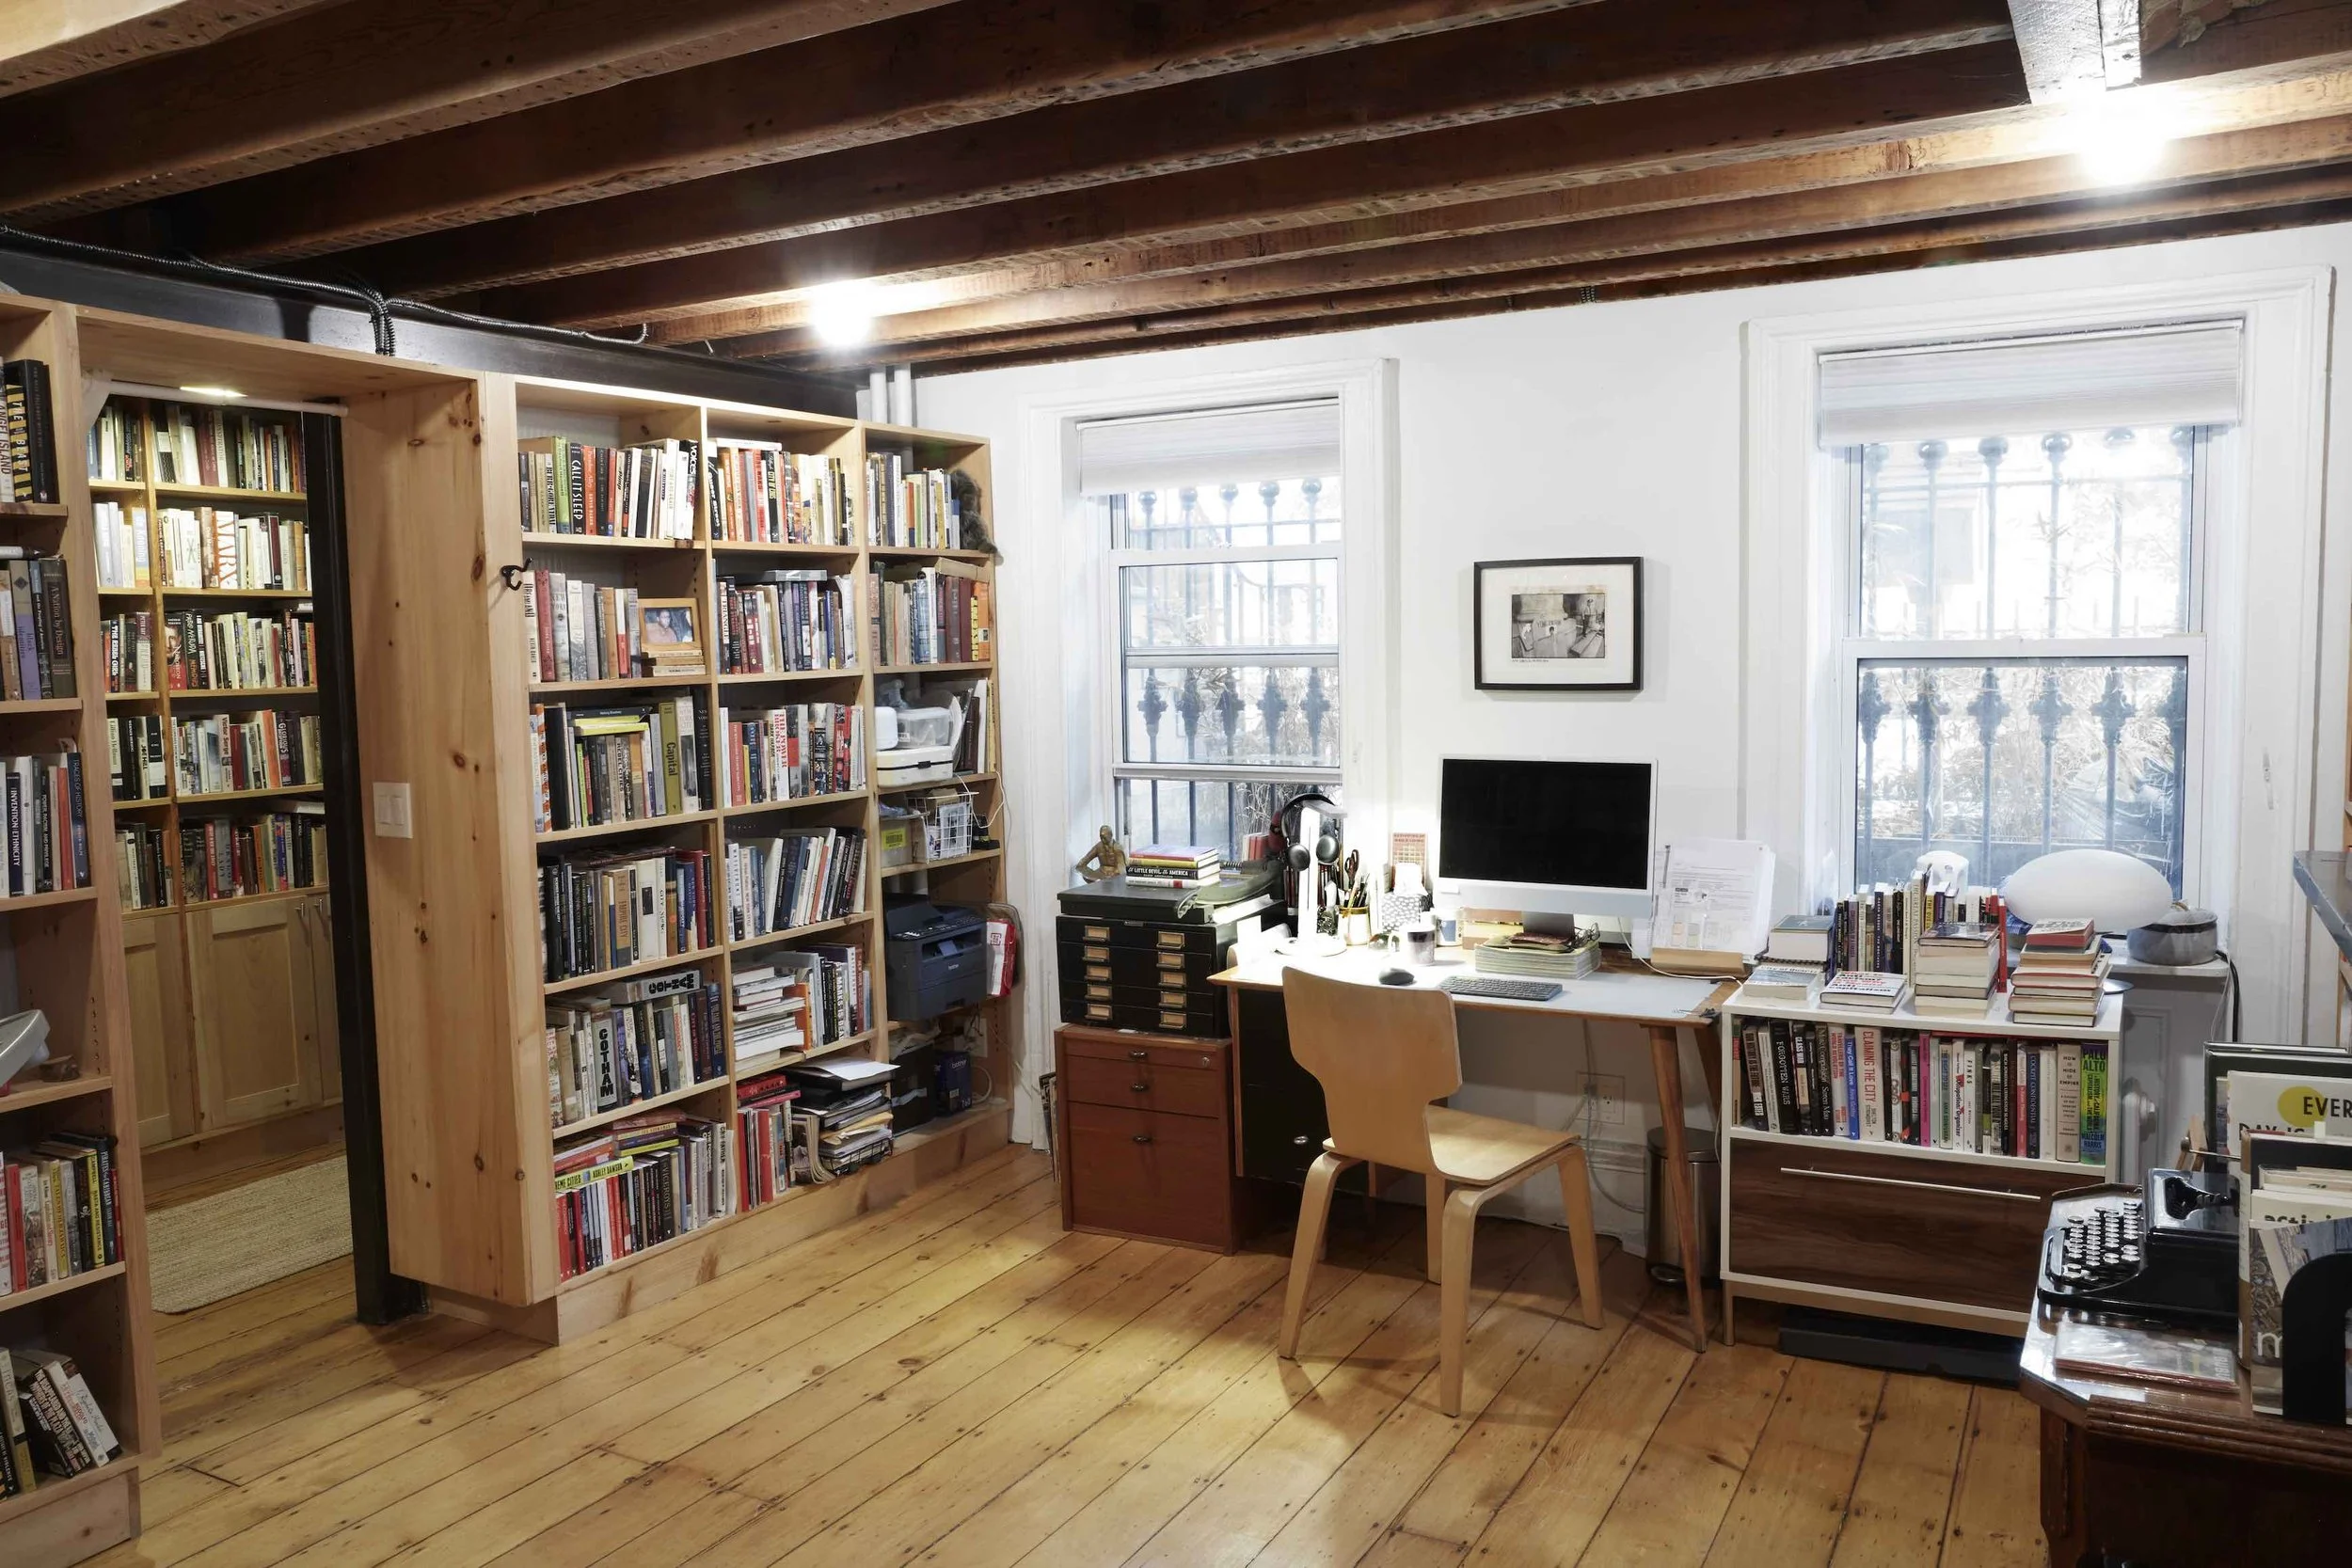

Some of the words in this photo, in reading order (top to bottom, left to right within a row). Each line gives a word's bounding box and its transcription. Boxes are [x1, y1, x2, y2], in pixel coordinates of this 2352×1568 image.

[12, 402, 24, 421] THE
[0, 438, 11, 474] ISLAND
[16, 439, 28, 472] BEAST
[689, 445, 697, 475] voices
[571, 459, 582, 480] CALL
[573, 493, 583, 520] SLEEP
[217, 519, 237, 582] MARX
[52, 594, 62, 618] Nation
[54, 620, 64, 629] by
[55, 630, 64, 655] Design
[279, 723, 289, 753] GLORIOUS
[666, 743, 678, 776] Capital
[74, 783, 81, 792] OF
[10, 790, 19, 828] INVENTION
[75, 792, 83, 817] HISTORY
[12, 830, 20, 866] ETHNICITY
[618, 901, 628, 923] EMPIRE
[620, 924, 628, 938] CITY
[649, 973, 694, 994] GOTHAM
[1795, 1037, 1804, 1052] CLASS
[1862, 1031, 1875, 1066] CLAIMING
[2082, 1050, 2106, 1061] PALO
[599, 1029, 614, 1097] GOTHAM
[1777, 1041, 1788, 1083] FORGOTTEN
[1818, 1046, 1827, 1083] Compulsion
[2083, 1061, 2106, 1072] ALTO
[1864, 1068, 1875, 1082] THE
[1781, 1086, 1790, 1105] WARS
[1865, 1085, 1876, 1103] CITY
[567, 1175, 581, 1186] CITIES
[593, 1167, 606, 1178] ASHLEY
[607, 1163, 622, 1175] DAWSON
[48, 1418, 63, 1435] PLAZA
[3, 1457, 12, 1481] VIOLENCE
